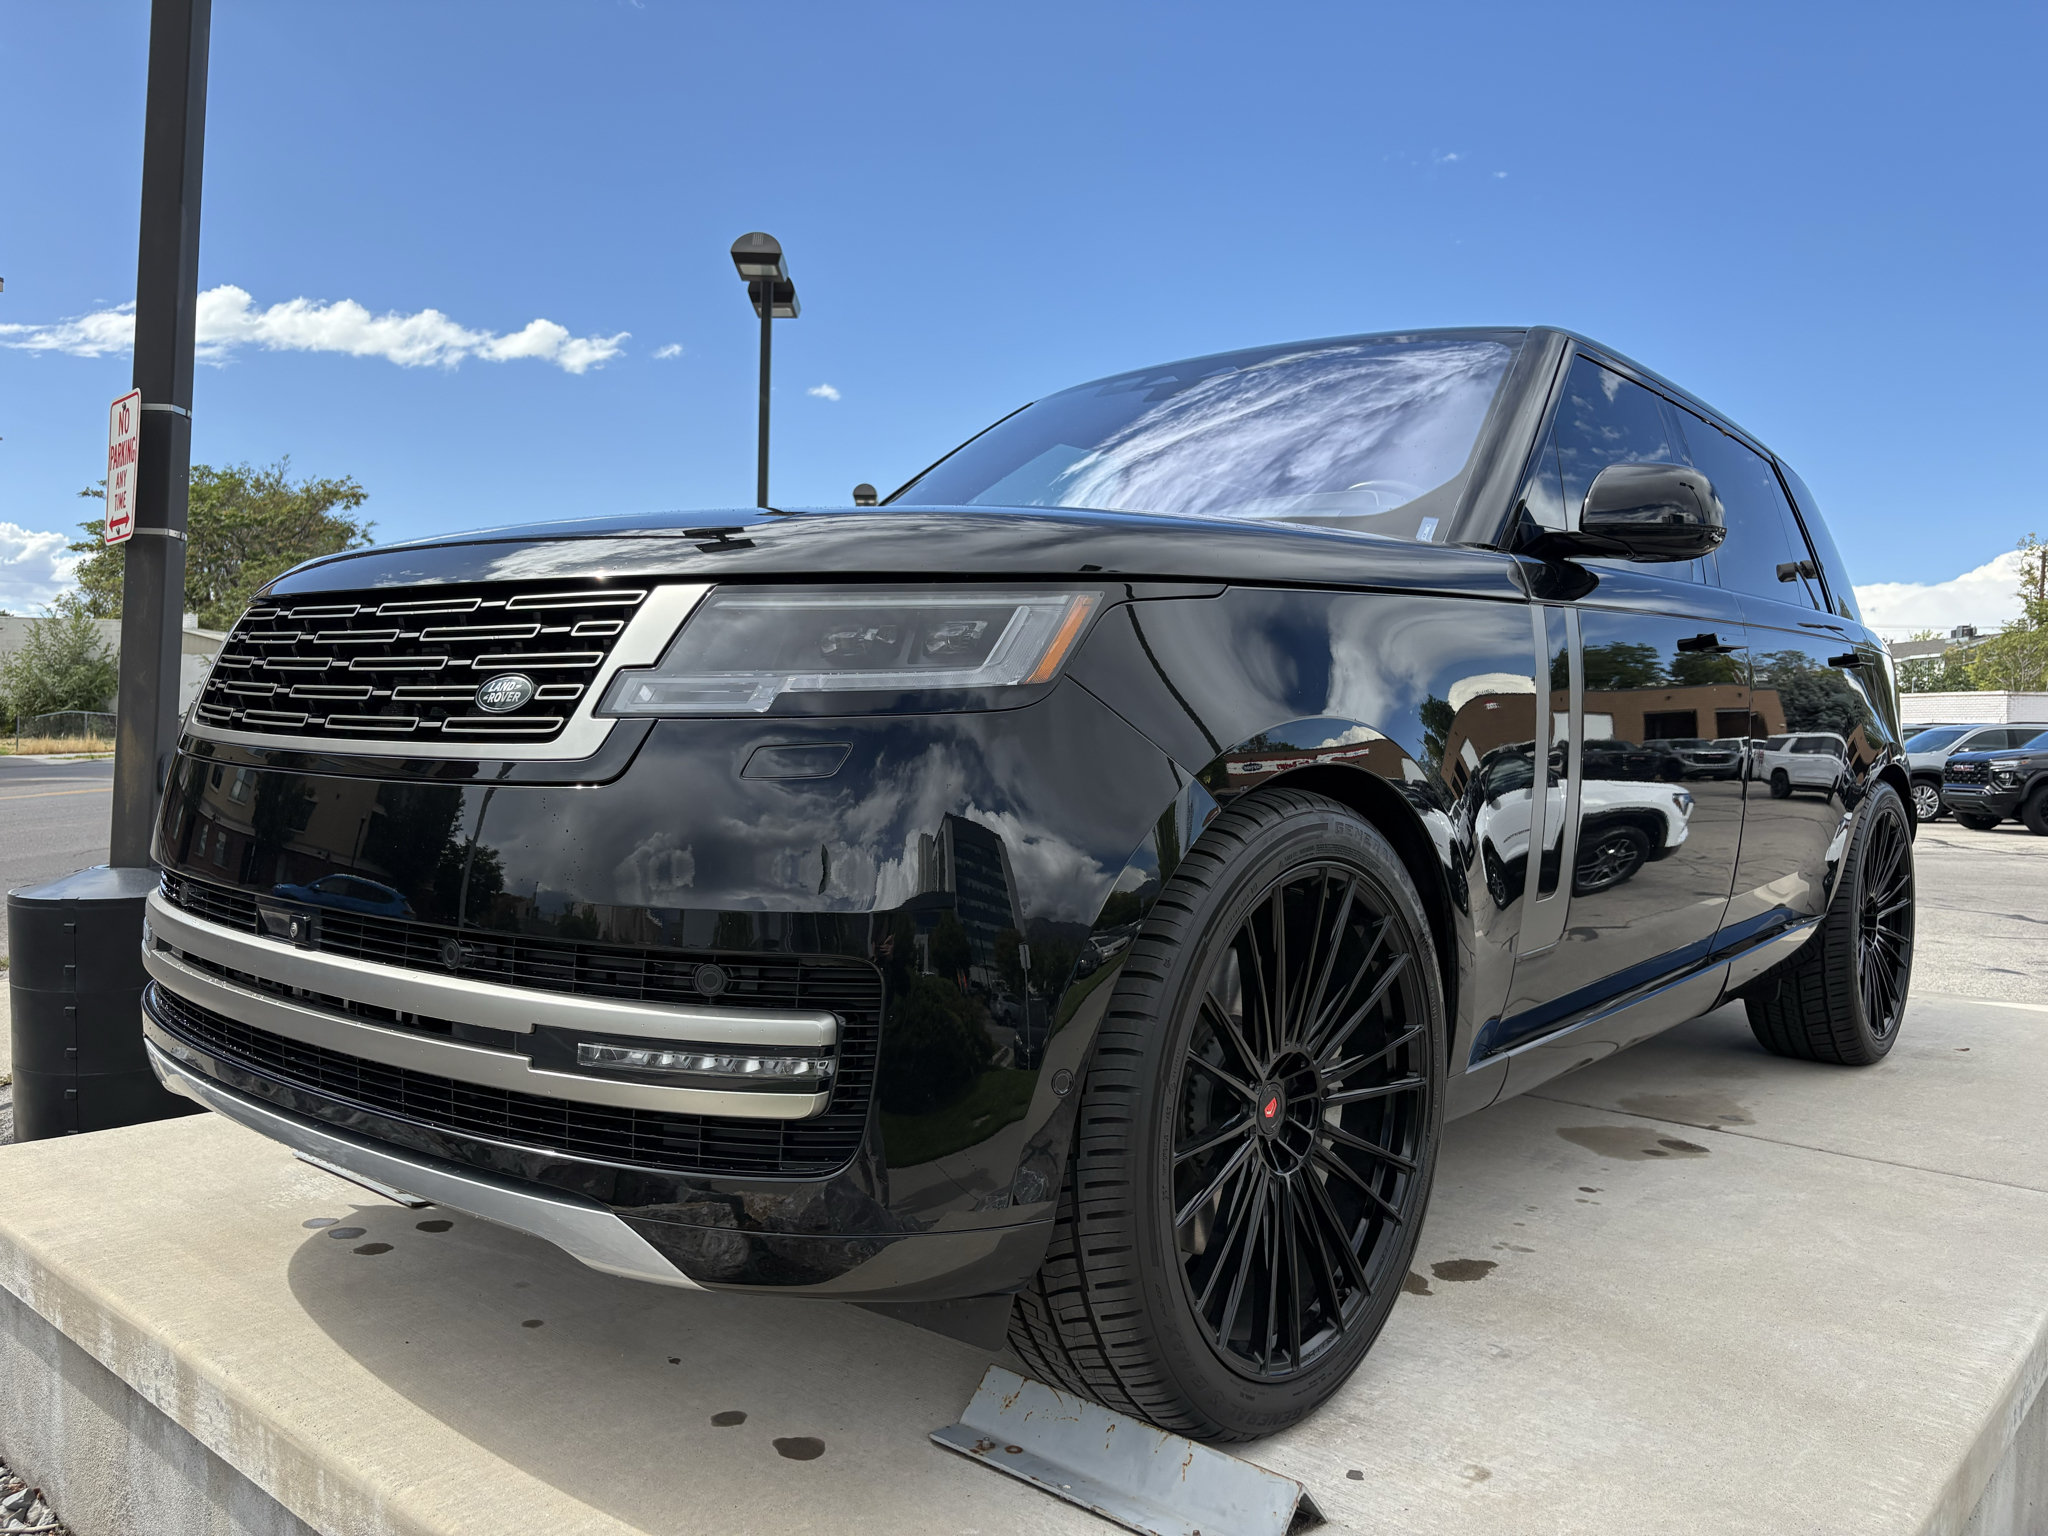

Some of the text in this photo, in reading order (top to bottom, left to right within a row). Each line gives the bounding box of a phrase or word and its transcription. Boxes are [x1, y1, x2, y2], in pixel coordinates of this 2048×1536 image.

[118, 408, 130, 436] NO
[110, 437, 136, 470] PARKING
[116, 469, 127, 490] ANY
[114, 491, 126, 511] TIME
[488, 681, 516, 692] LAND
[487, 692, 521, 703] ROVER
[1334, 820, 1395, 869] GENERAL
